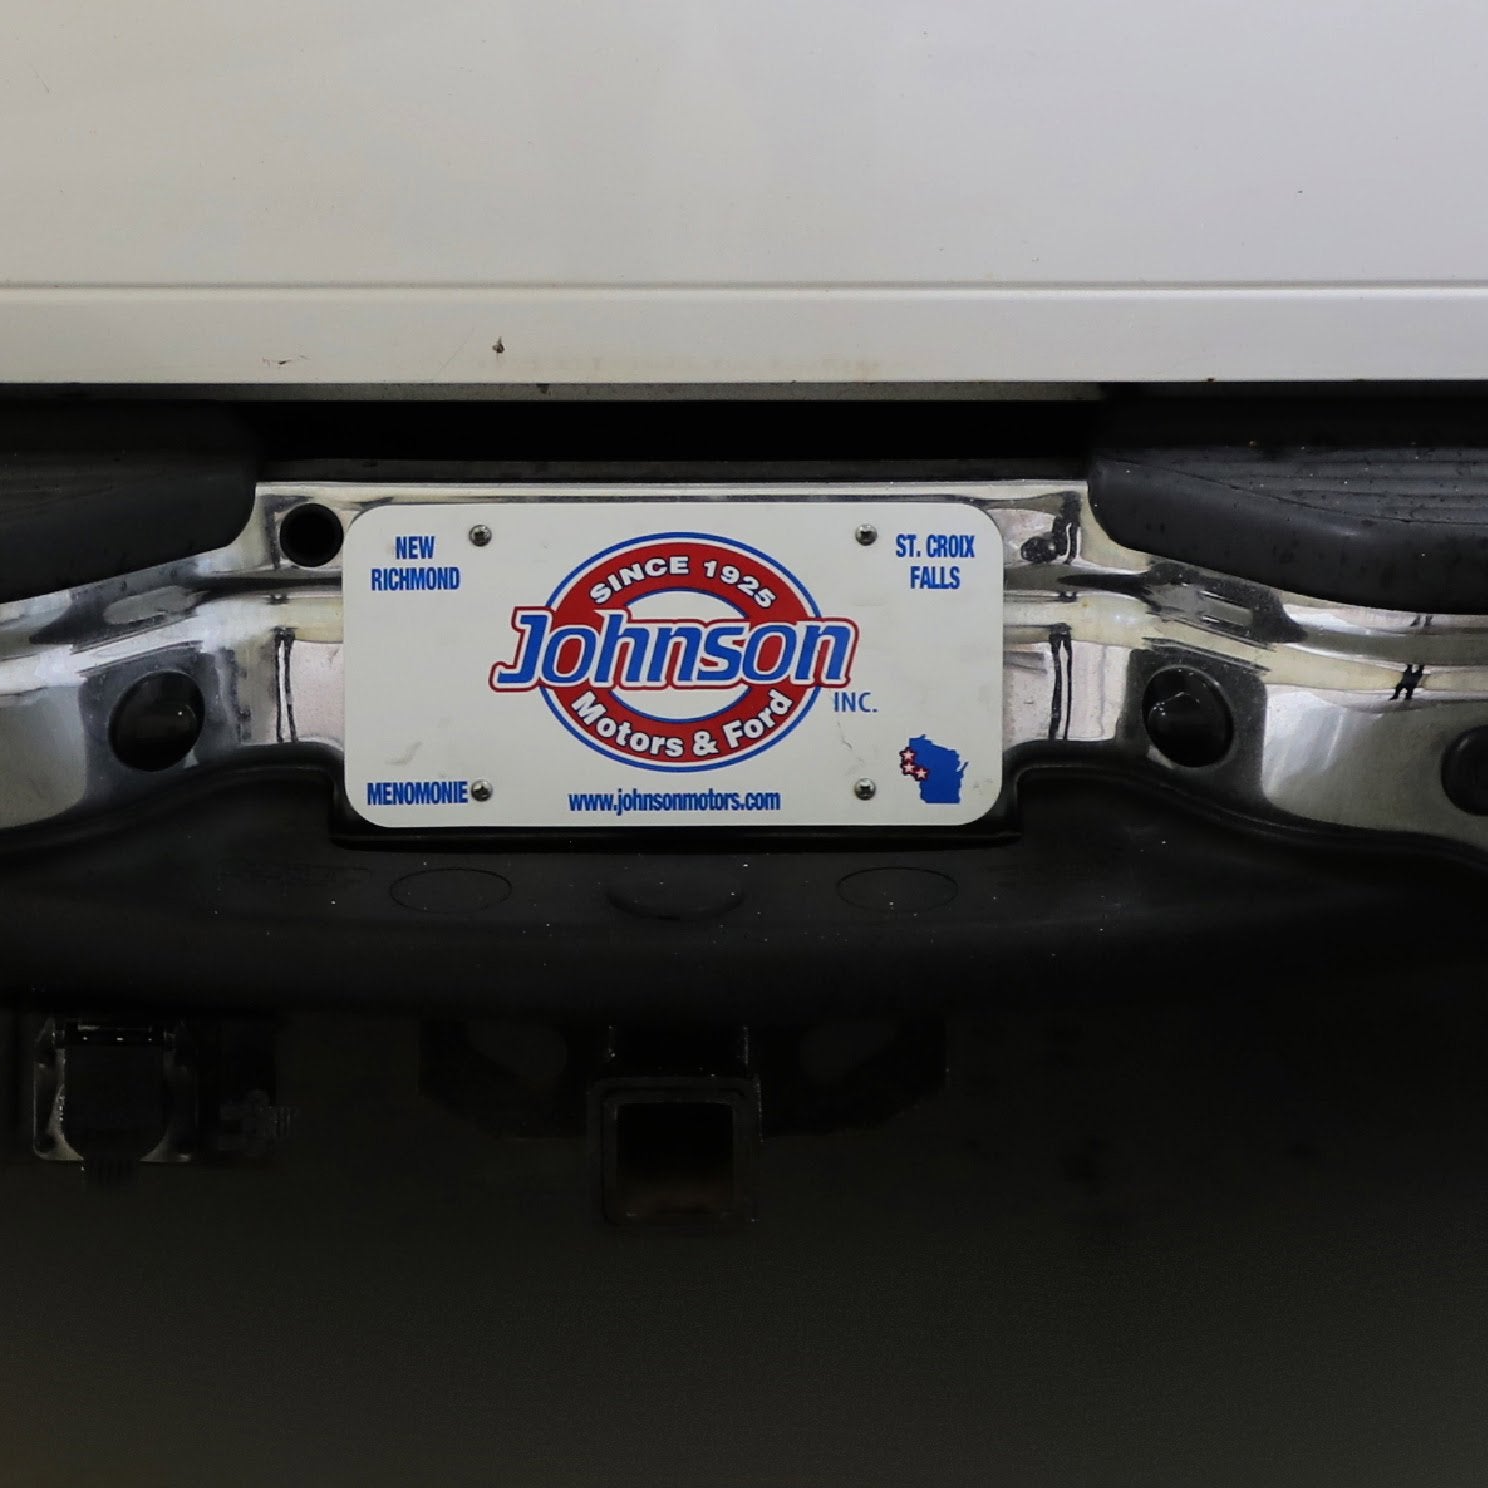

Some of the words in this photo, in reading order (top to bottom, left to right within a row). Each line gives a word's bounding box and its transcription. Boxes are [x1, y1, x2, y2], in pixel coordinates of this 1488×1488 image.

[395, 536, 435, 560] NEW
[895, 534, 921, 558] ST.
[926, 535, 975, 558] CROIX
[371, 567, 460, 591] RICHMOND
[590, 556, 689, 604] SINCE
[703, 560, 776, 609] 1925
[910, 566, 960, 589] FALLS
[496, 613, 850, 684] Johnson
[834, 692, 878, 713] INC.
[570, 692, 684, 758] Motors
[693, 730, 718, 757] &
[723, 689, 793, 748] Ford
[367, 782, 469, 806] MENOMONIE
[569, 788, 781, 815] www.johnsonmotors.com
